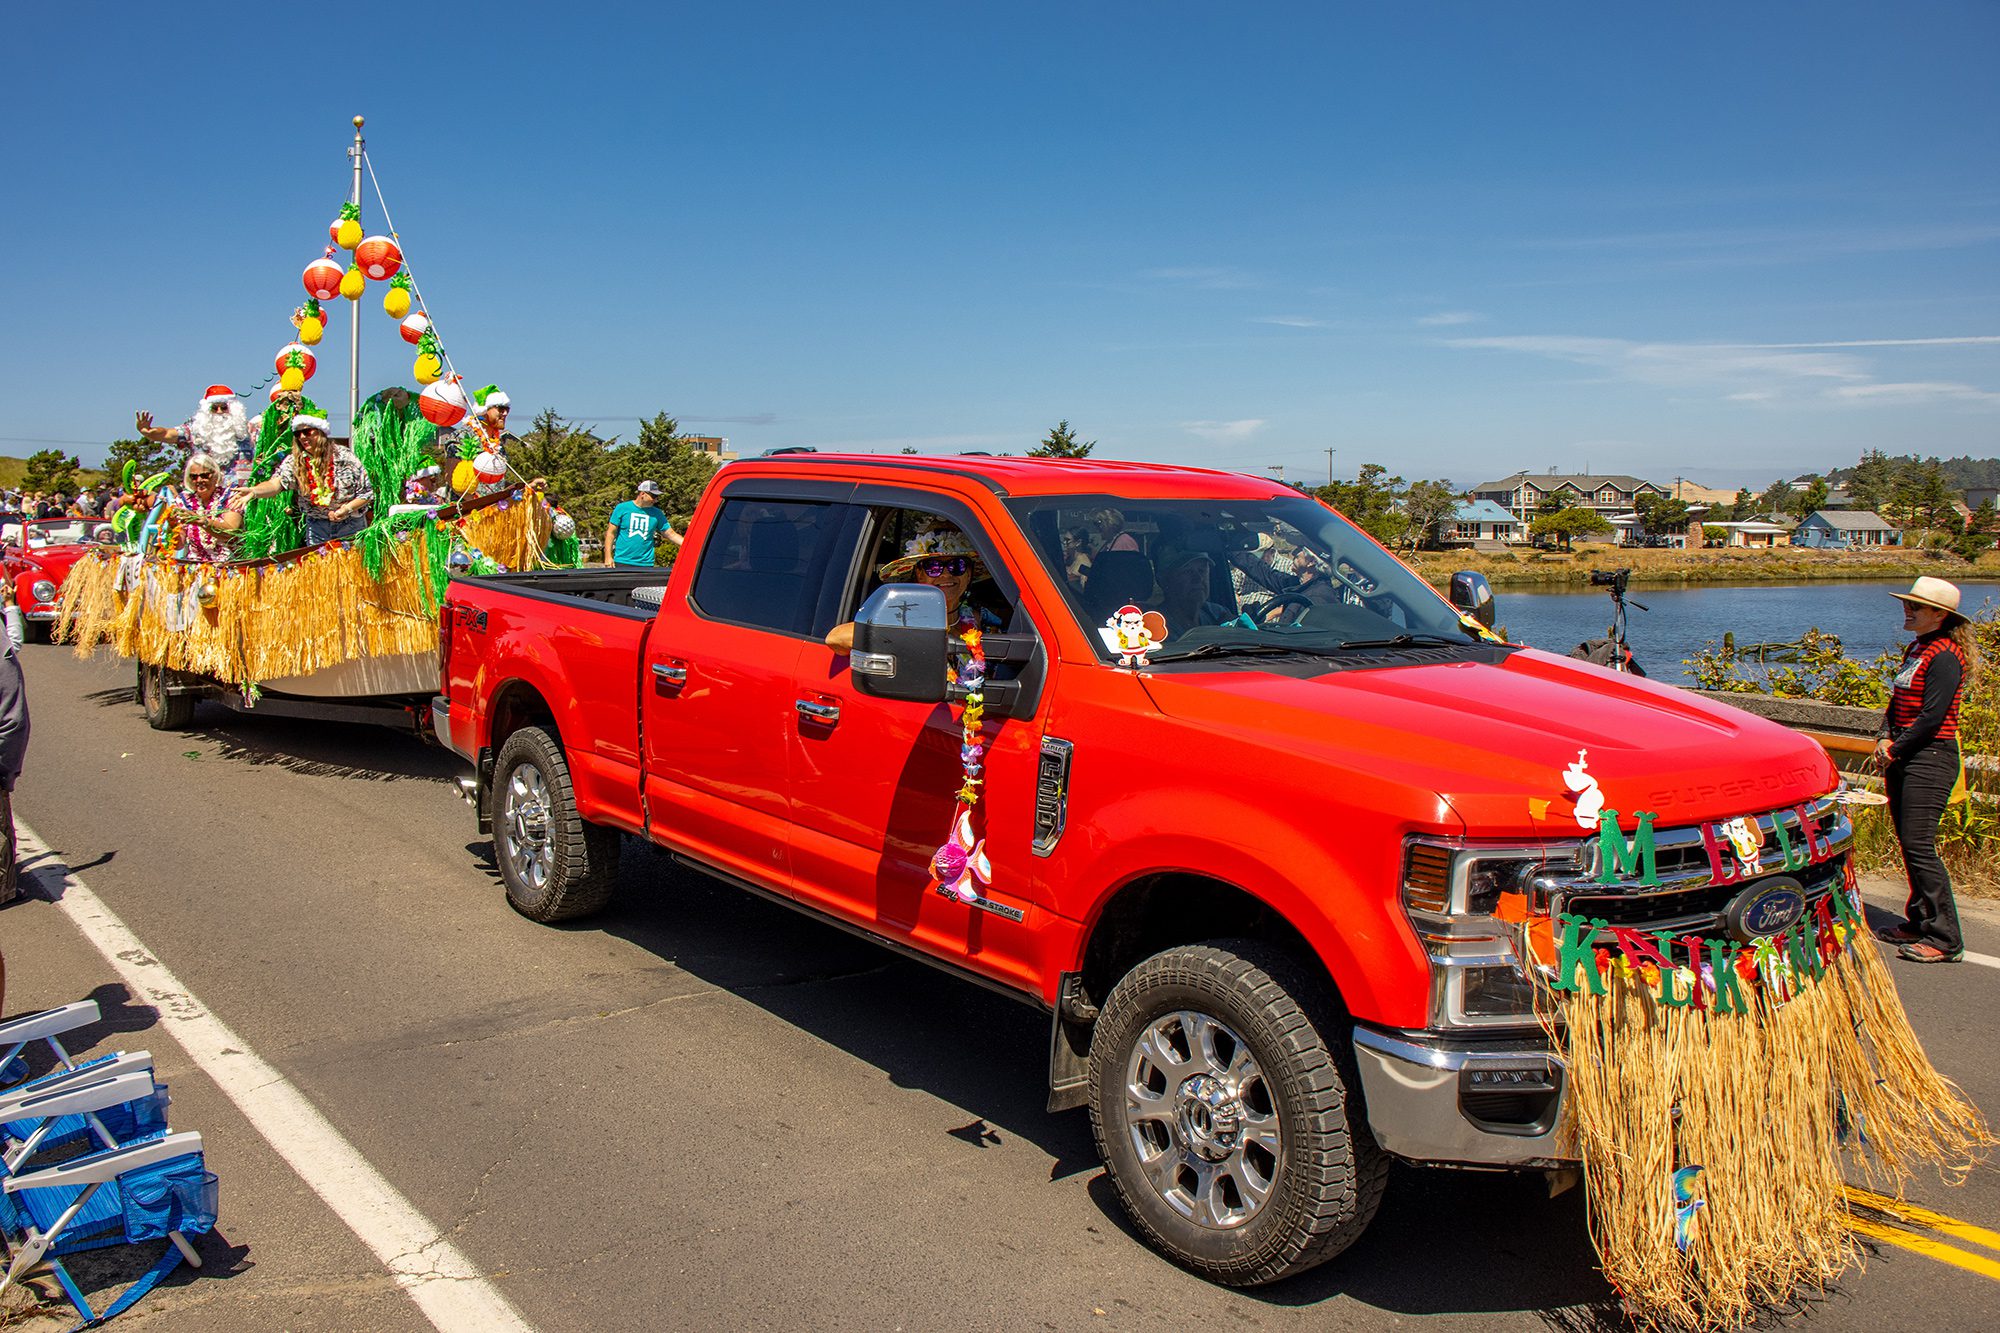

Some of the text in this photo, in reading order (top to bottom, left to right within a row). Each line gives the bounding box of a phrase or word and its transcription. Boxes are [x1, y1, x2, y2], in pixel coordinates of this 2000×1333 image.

[456, 604, 488, 630] FX4
[1649, 764, 1820, 807] SUPER DUTY
[1595, 804, 1837, 887] MELE
[988, 902, 1020, 918] STROKE
[1758, 898, 1795, 929] Ford
